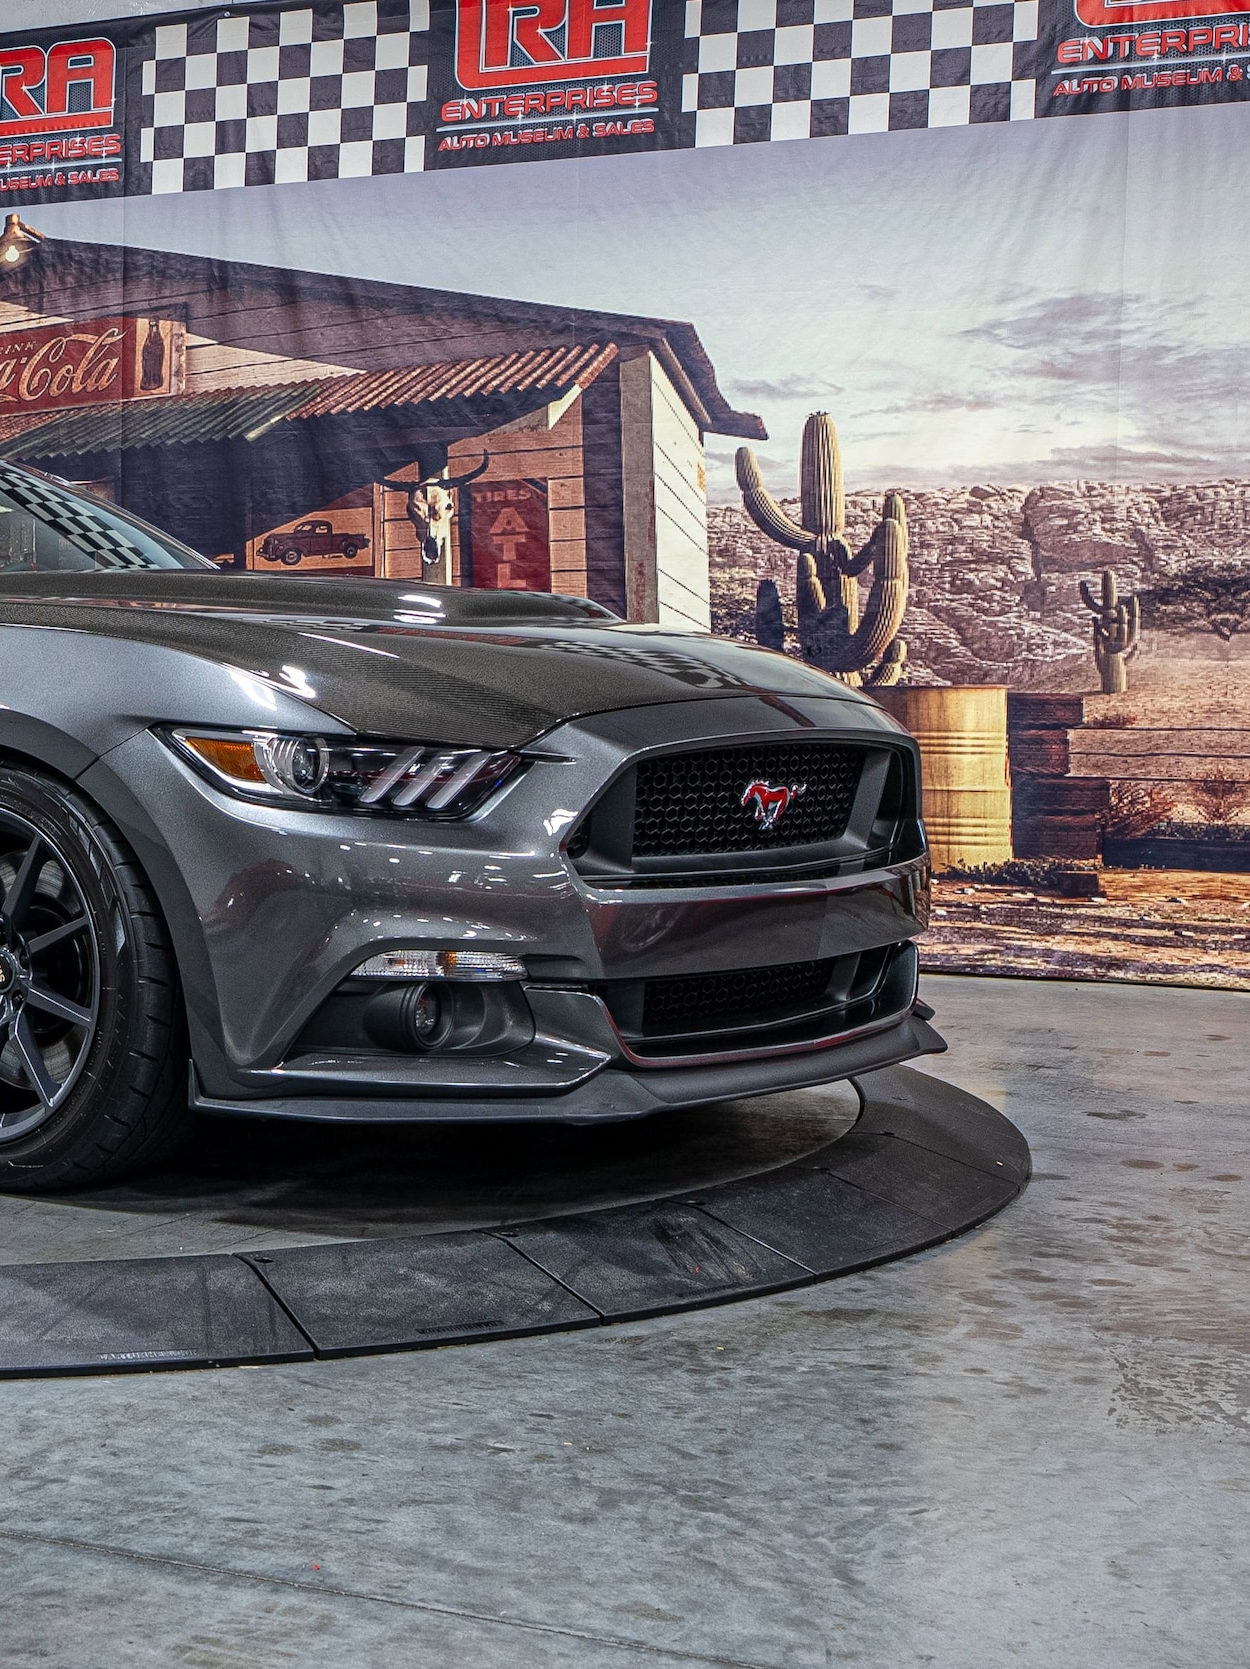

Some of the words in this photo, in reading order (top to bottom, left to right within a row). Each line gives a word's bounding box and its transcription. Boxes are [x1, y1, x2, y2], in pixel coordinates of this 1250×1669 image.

[1057, 22, 1250, 63] ENTERPRI
[1053, 76, 1118, 97] AUTO
[1120, 67, 1223, 91] MUSEUM
[1226, 64, 1244, 82] &
[441, 81, 658, 122] ENTERPRISES
[438, 134, 490, 151] AUTO
[492, 125, 574, 147] MUSEUM
[577, 124, 589, 138] &
[592, 119, 655, 137] SALES
[54, 171, 66, 186] &
[68, 168, 120, 185] SALES
[472, 488, 532, 502] TIRES
